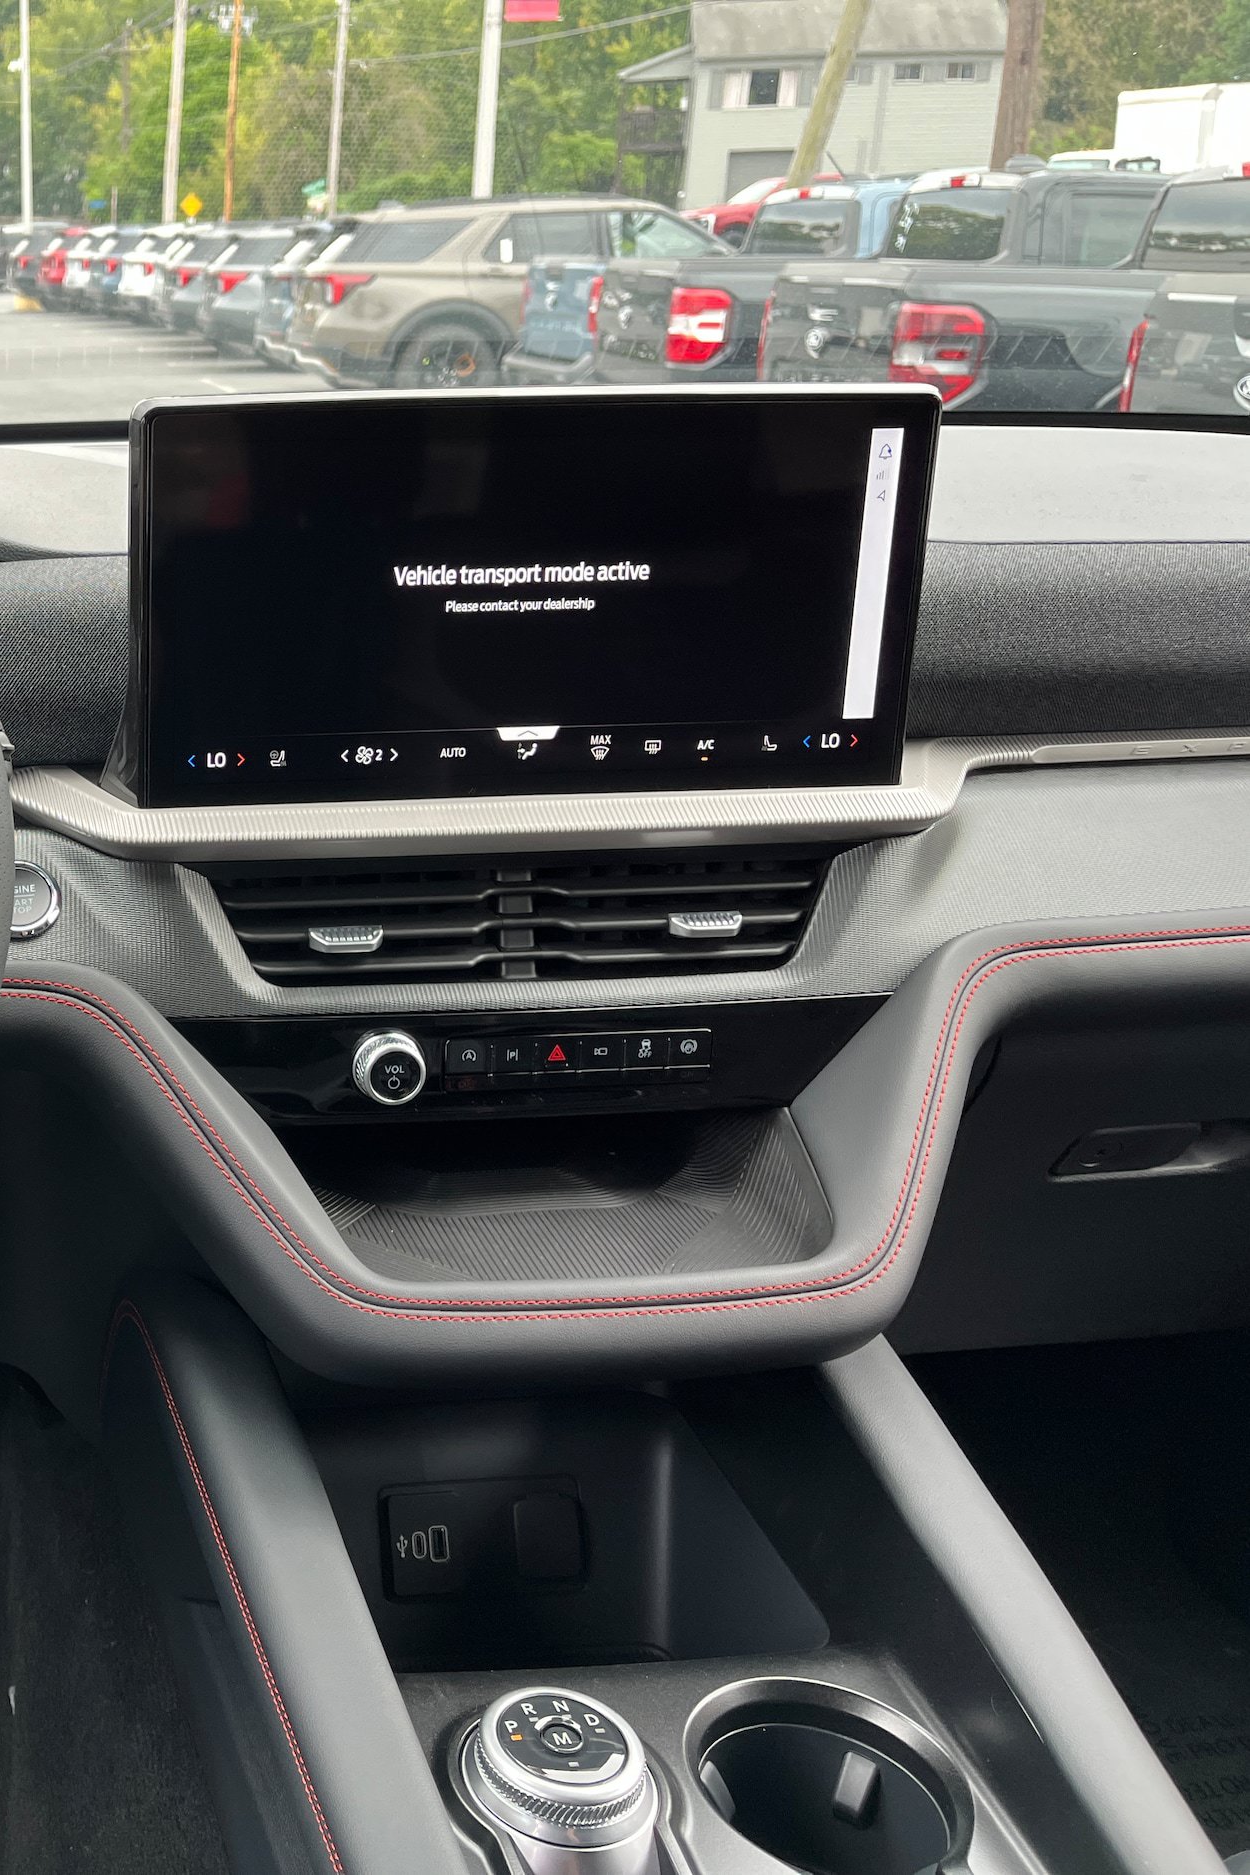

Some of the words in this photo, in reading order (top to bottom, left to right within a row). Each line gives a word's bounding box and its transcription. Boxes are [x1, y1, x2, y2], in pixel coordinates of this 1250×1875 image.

[394, 565, 456, 586] Vehicle
[459, 564, 541, 586] transport
[544, 561, 594, 583] mode
[596, 561, 651, 581] active
[445, 600, 479, 612] Please
[479, 599, 519, 611] contact
[519, 601, 543, 612] your
[543, 597, 595, 610] dealership
[590, 734, 612, 745] MAX
[697, 739, 715, 750] A/C
[821, 733, 840, 749] LO
[375, 750, 383, 761] 2
[440, 747, 466, 759] AUTO
[206, 752, 227, 768] LO
[14, 884, 36, 894] GINE
[14, 898, 33, 906] ART
[638, 1051, 652, 1059] OFF
[384, 1065, 405, 1074] VOL
[504, 1720, 518, 1733] P
[520, 1703, 537, 1715] R
[552, 1700, 570, 1712] N
[584, 1713, 600, 1726] D
[552, 1732, 573, 1746] M
